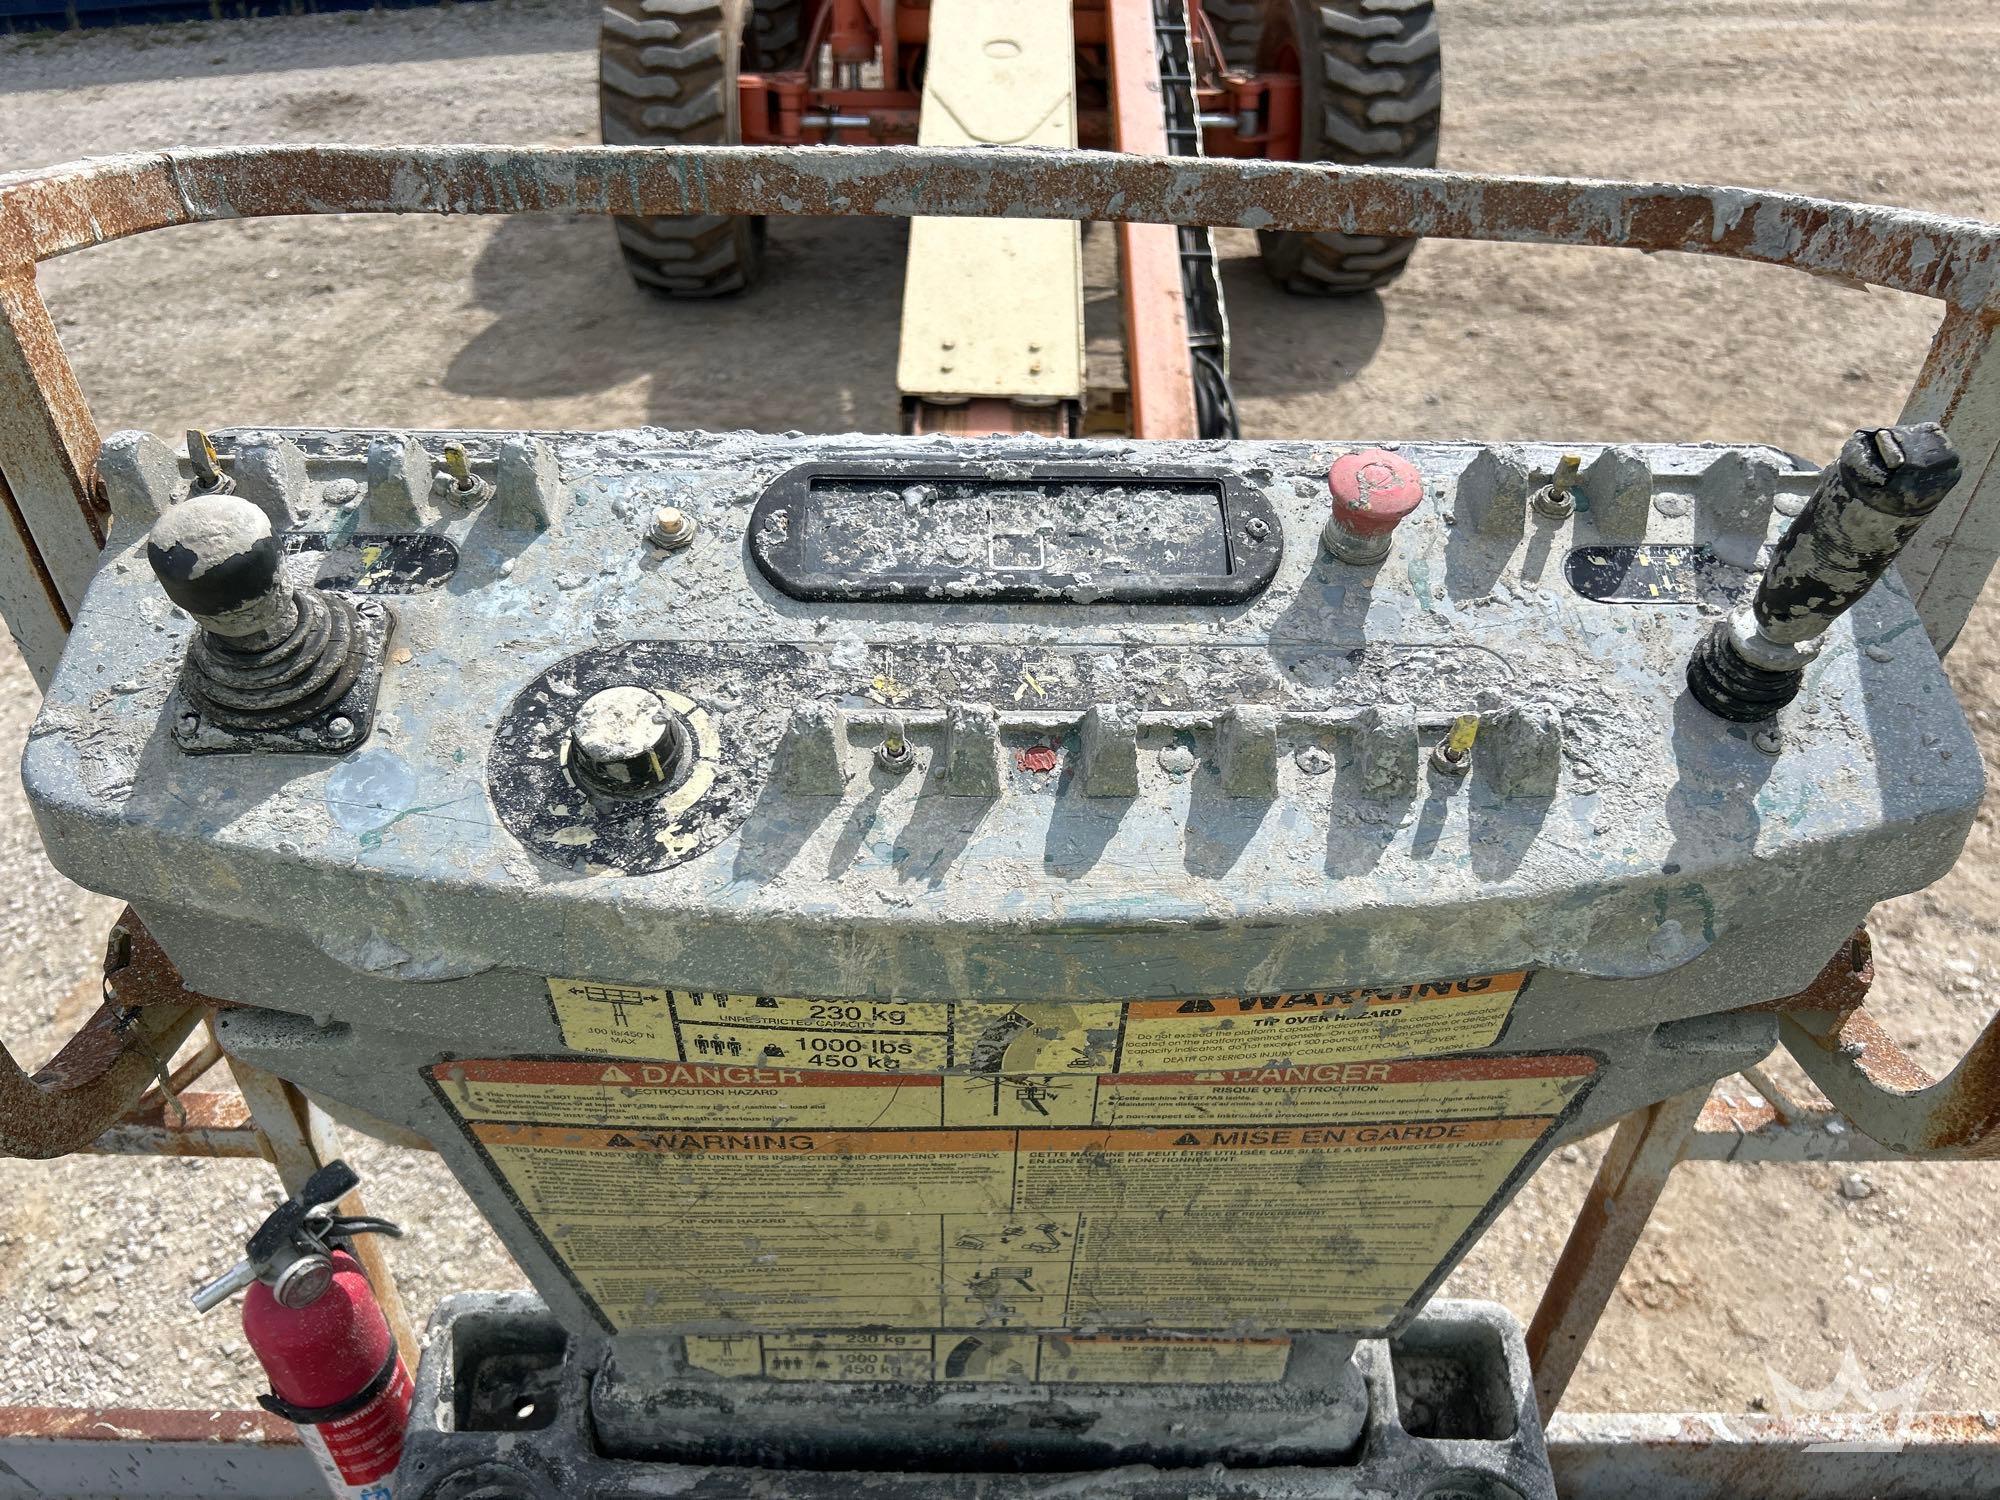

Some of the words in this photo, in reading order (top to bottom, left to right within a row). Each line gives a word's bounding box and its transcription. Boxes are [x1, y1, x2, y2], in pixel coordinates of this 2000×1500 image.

[809, 1005, 862, 1021] 230
[872, 1007, 907, 1025] kg
[816, 1019, 875, 1029] CAPACITY
[1253, 1017, 1280, 1027] TIP
[1285, 1014, 1329, 1025] OVER
[1335, 1009, 1402, 1021] HZARD
[647, 1032, 655, 1040] N
[1125, 1040, 1165, 1048] located
[1202, 1036, 1245, 1045] platform
[1246, 1034, 1283, 1042] control
[1347, 1027, 1370, 1035] units
[1462, 1012, 1505, 1023] defaced
[1155, 1032, 1172, 1040] not
[1174, 1031, 1213, 1039] exceed
[1233, 1027, 1276, 1037] platform
[1278, 1024, 1324, 1034] capacity
[1325, 1020, 1373, 1030] indicated
[610, 1037, 637, 1045] MAX
[795, 1037, 862, 1053] 1000
[871, 1039, 913, 1055] lbs
[1127, 1047, 1172, 1055] capacity
[1244, 1042, 1260, 1050] not
[1263, 1039, 1301, 1048] exceed
[1304, 1038, 1321, 1046] 500
[1322, 1036, 1359, 1045] pounds
[1410, 1026, 1451, 1036] platform
[1163, 1055, 1197, 1063] DEATH
[1199, 1054, 1214, 1062] OR
[1216, 1052, 1257, 1061] SERIOUS
[1259, 1049, 1294, 1058] INJURY
[1296, 1047, 1334, 1056] COULD
[1335, 1043, 1368, 1053] RESULT
[1370, 1041, 1399, 1050] FROM
[807, 1054, 858, 1067] 450
[868, 1055, 901, 1072] kg
[641, 1066, 804, 1084] DANGER
[621, 1088, 725, 1096] ECTROCUTION
[1212, 1086, 1259, 1094] RISQUE
[650, 1135, 815, 1150] WARNING
[1212, 1130, 1292, 1145] MISE
[1302, 1129, 1346, 1143] EN
[1356, 1125, 1470, 1142] GARDE
[533, 1147, 587, 1157] MACHINE
[626, 1152, 649, 1160] NOT
[846, 1335, 879, 1343] 230
[885, 1335, 906, 1345] kg
[844, 1364, 875, 1374] 450
